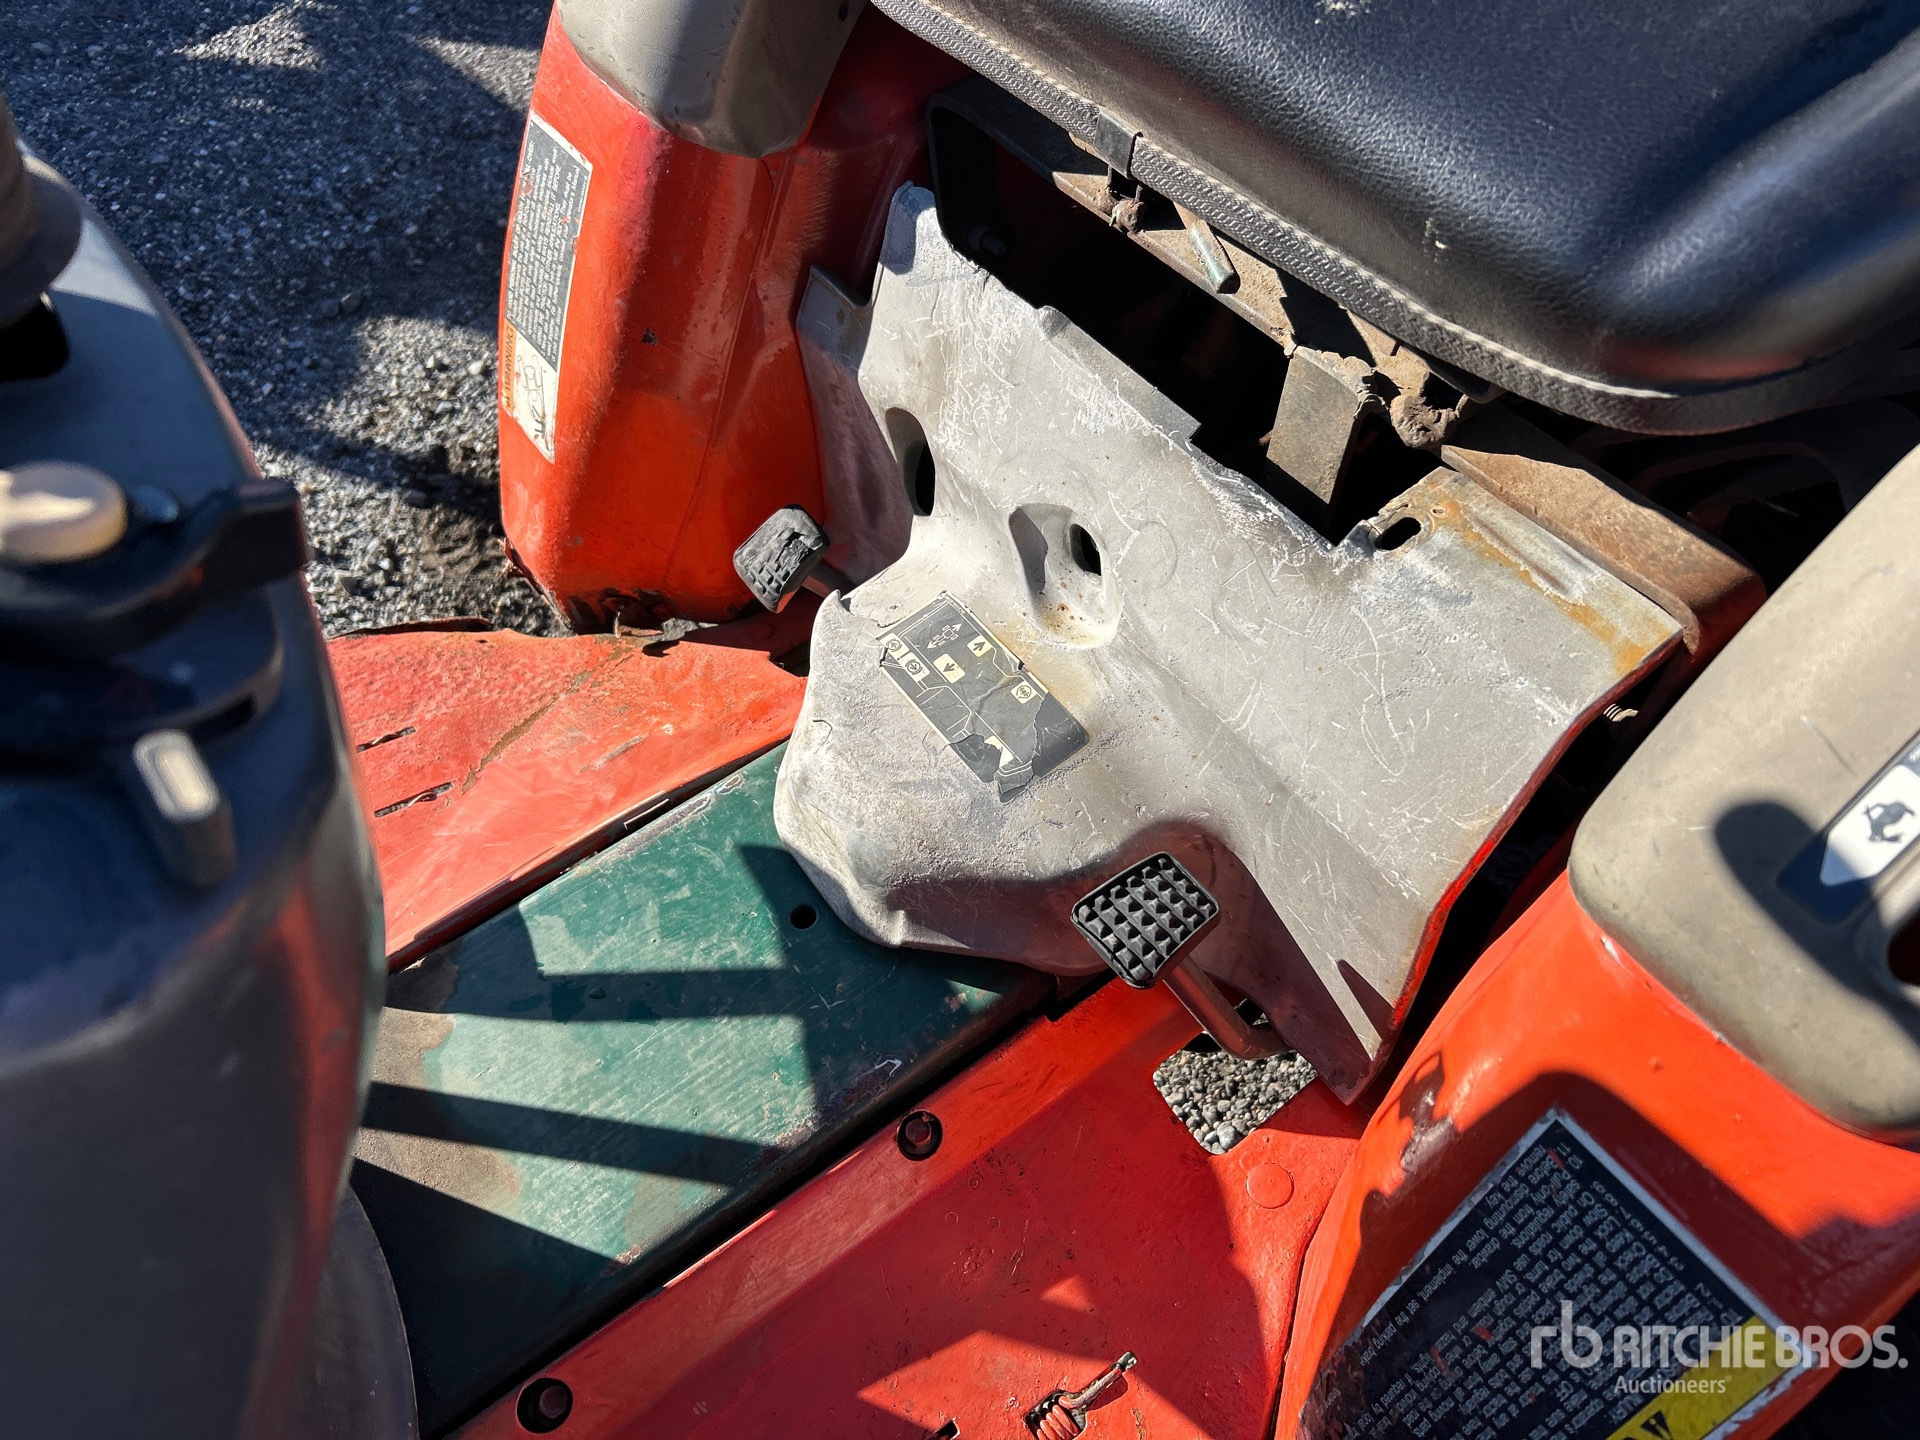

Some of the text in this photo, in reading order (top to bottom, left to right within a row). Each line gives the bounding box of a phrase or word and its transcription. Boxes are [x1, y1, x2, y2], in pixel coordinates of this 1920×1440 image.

[503, 325, 514, 391] WARNING
[1484, 1144, 1546, 1208] remove the key.
[1527, 1153, 1560, 1184] Before
[1589, 1180, 1605, 1193] 9.
[1482, 1182, 1532, 1229] dismounting
[1576, 1191, 1595, 1207] On
[1602, 1192, 1618, 1206] 8.
[1468, 1154, 1583, 1269] 10. Pull only from the drawbar.
[1509, 1175, 1580, 1248] safety regulations.
[1550, 1203, 1579, 1233] public
[1582, 1203, 1608, 1226] Slow
[1615, 1205, 1632, 1220] 7.
[1465, 1227, 1489, 1251] lower
[1558, 1224, 1584, 1249] down
[1592, 1214, 1621, 1242] Lock
[1605, 1227, 1633, 1253] Keep
[1528, 1230, 1553, 1255] roads
[1546, 1247, 1562, 1262] for
[1577, 1237, 1597, 1254] the
[1451, 1248, 1468, 1265] the
[1512, 1253, 1529, 1271] use
[1561, 1252, 1582, 1271] two
[1591, 1250, 1607, 1268] all
[1416, 1262, 1455, 1301] implement,
[1495, 1269, 1517, 1293] SMV
[1522, 1259, 1549, 1282] turns,
[1538, 1268, 1566, 1293] brake
[1563, 1263, 1594, 1293] shields
[1514, 1282, 1525, 1295] or
[1405, 1299, 1419, 1315] set
[1467, 1287, 1496, 1317] emblem
[1492, 1288, 1515, 1315] rough
[1512, 1288, 1540, 1318] pedals
[1394, 1311, 1409, 1326] the
[1452, 1315, 1468, 1334] and
[1371, 1321, 1396, 1349] parking
[1430, 1330, 1456, 1360] hazar
[1461, 1334, 1471, 1347] or
[1497, 1336, 1518, 1355] stay
[1461, 1343, 1487, 1368] before
[1474, 1346, 1500, 1374] away
[1403, 1372, 1414, 1385] if
[1413, 1359, 1447, 1391] pplying
[1462, 1371, 1483, 1391] from
[1379, 1378, 1405, 1408] required
[1452, 1386, 1465, 1402] all
[1370, 1402, 1384, 1414] by
[1427, 1396, 1455, 1421] moving
